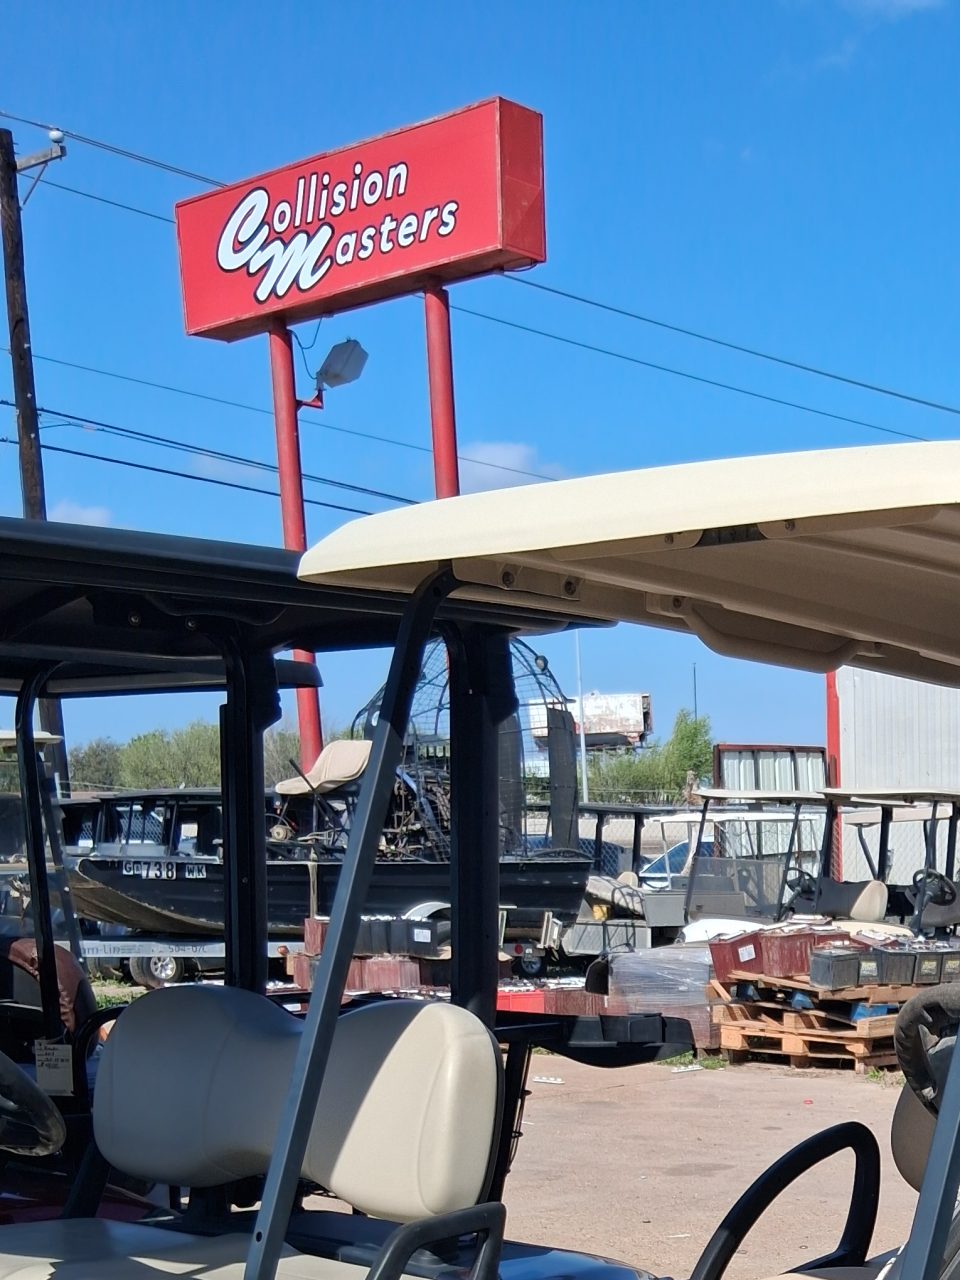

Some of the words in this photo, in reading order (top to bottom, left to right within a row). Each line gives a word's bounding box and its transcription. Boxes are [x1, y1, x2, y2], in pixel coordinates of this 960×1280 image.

[217, 161, 409, 272] Collision
[250, 199, 460, 303] Masters
[186, 864, 206, 878] WK
